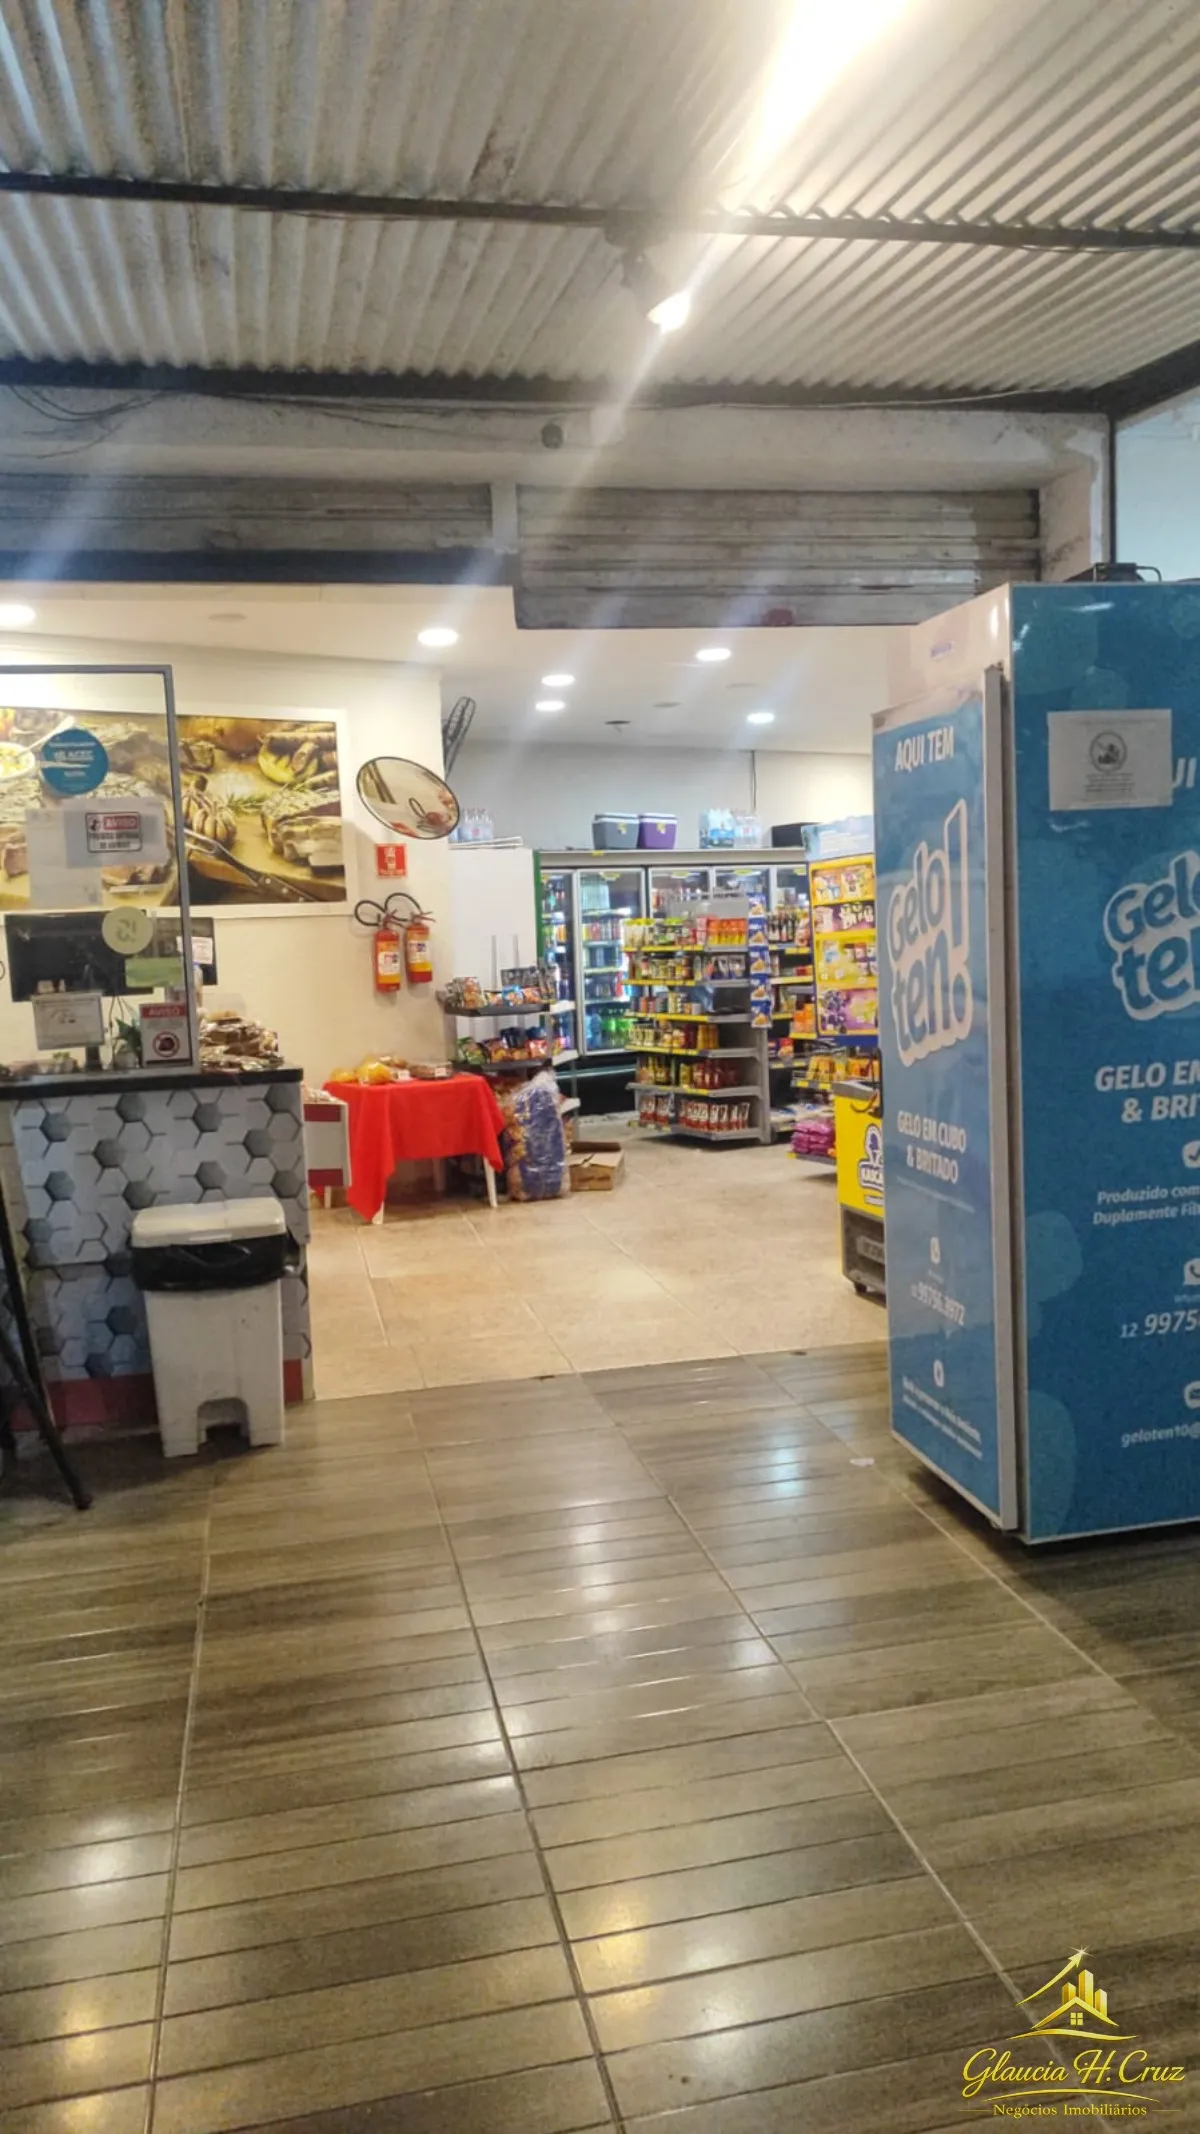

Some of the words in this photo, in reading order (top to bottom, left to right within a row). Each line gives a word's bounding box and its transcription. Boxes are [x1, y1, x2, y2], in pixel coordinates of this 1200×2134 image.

[894, 734, 926, 773] AQUI
[927, 725, 955, 763] TEM
[105, 817, 137, 828] AVISO
[888, 843, 946, 964] Gelo
[1094, 1062, 1167, 1092] GELO
[1120, 1097, 1144, 1124] &
[1150, 1092, 1200, 1121] BRI
[1097, 1186, 1168, 1205] Produzido
[1092, 1205, 1179, 1227] Duplamente
[1120, 1322, 1139, 1339] 12
[1144, 1308, 1200, 1336] 9975
